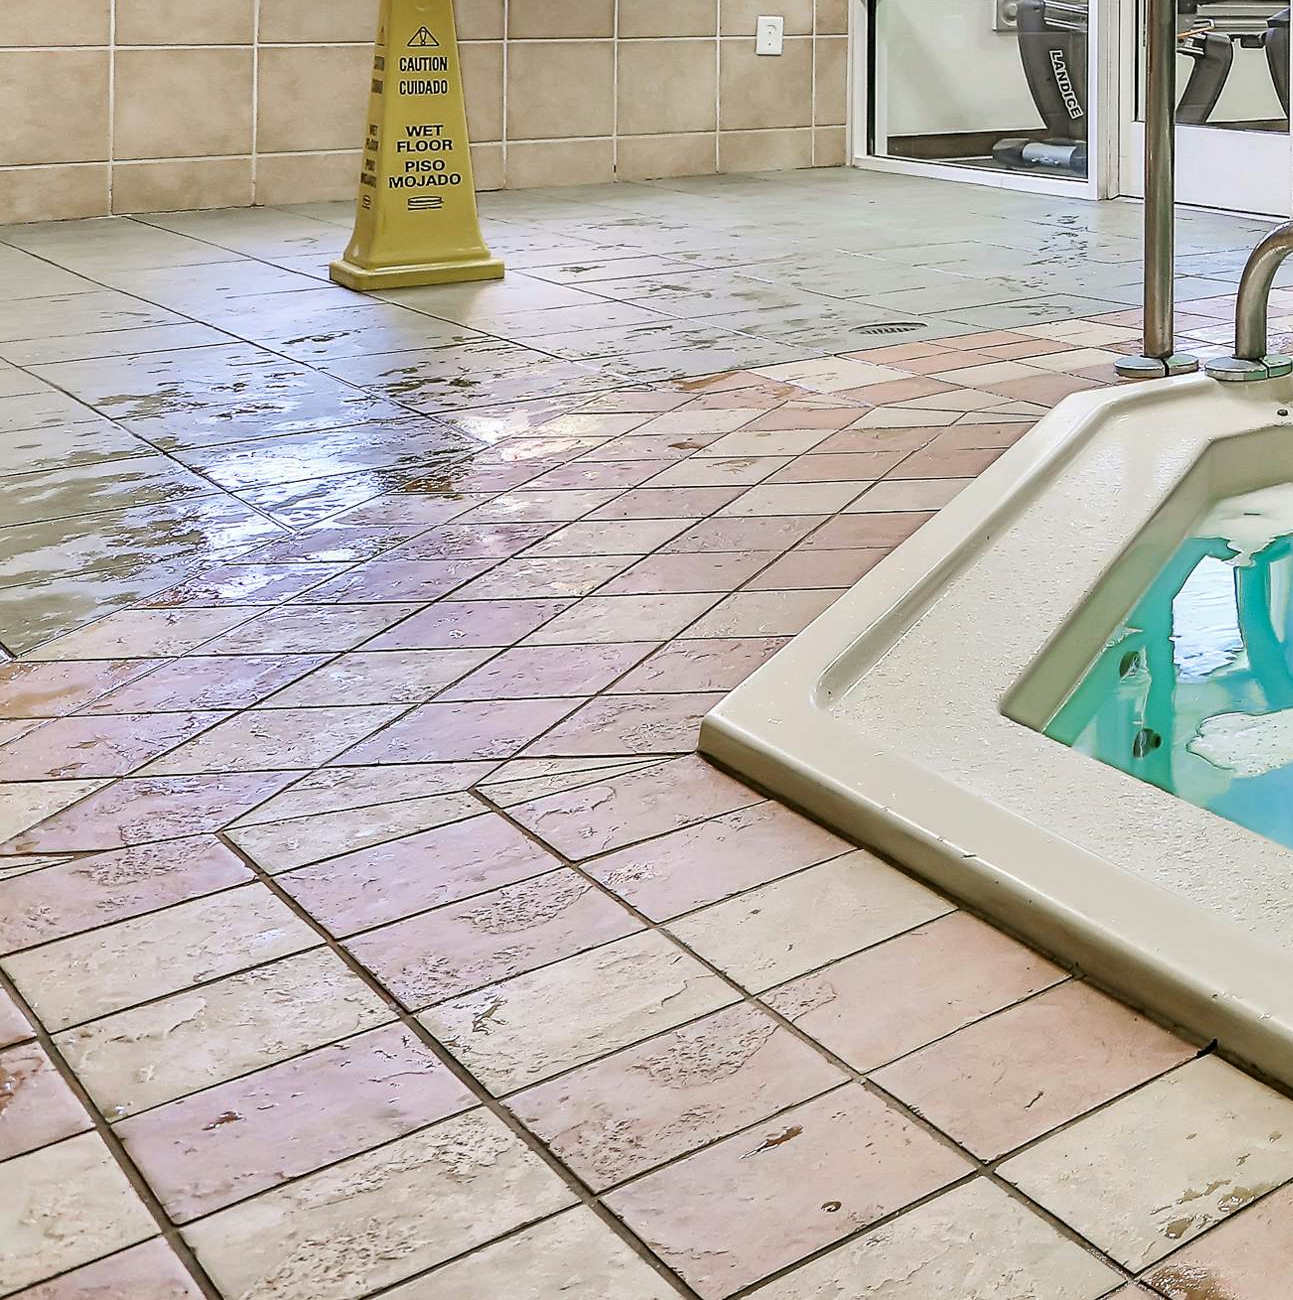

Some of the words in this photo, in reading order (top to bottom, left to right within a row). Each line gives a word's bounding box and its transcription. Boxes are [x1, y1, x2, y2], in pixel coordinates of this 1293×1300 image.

[399, 56, 448, 72] CAUTION
[399, 79, 448, 95] CUIDADO
[1049, 50, 1084, 119] LANDICE
[405, 124, 444, 137] WET
[396, 139, 453, 153] FLOOR
[405, 159, 446, 173] PISO
[388, 173, 462, 189] MOJADO
